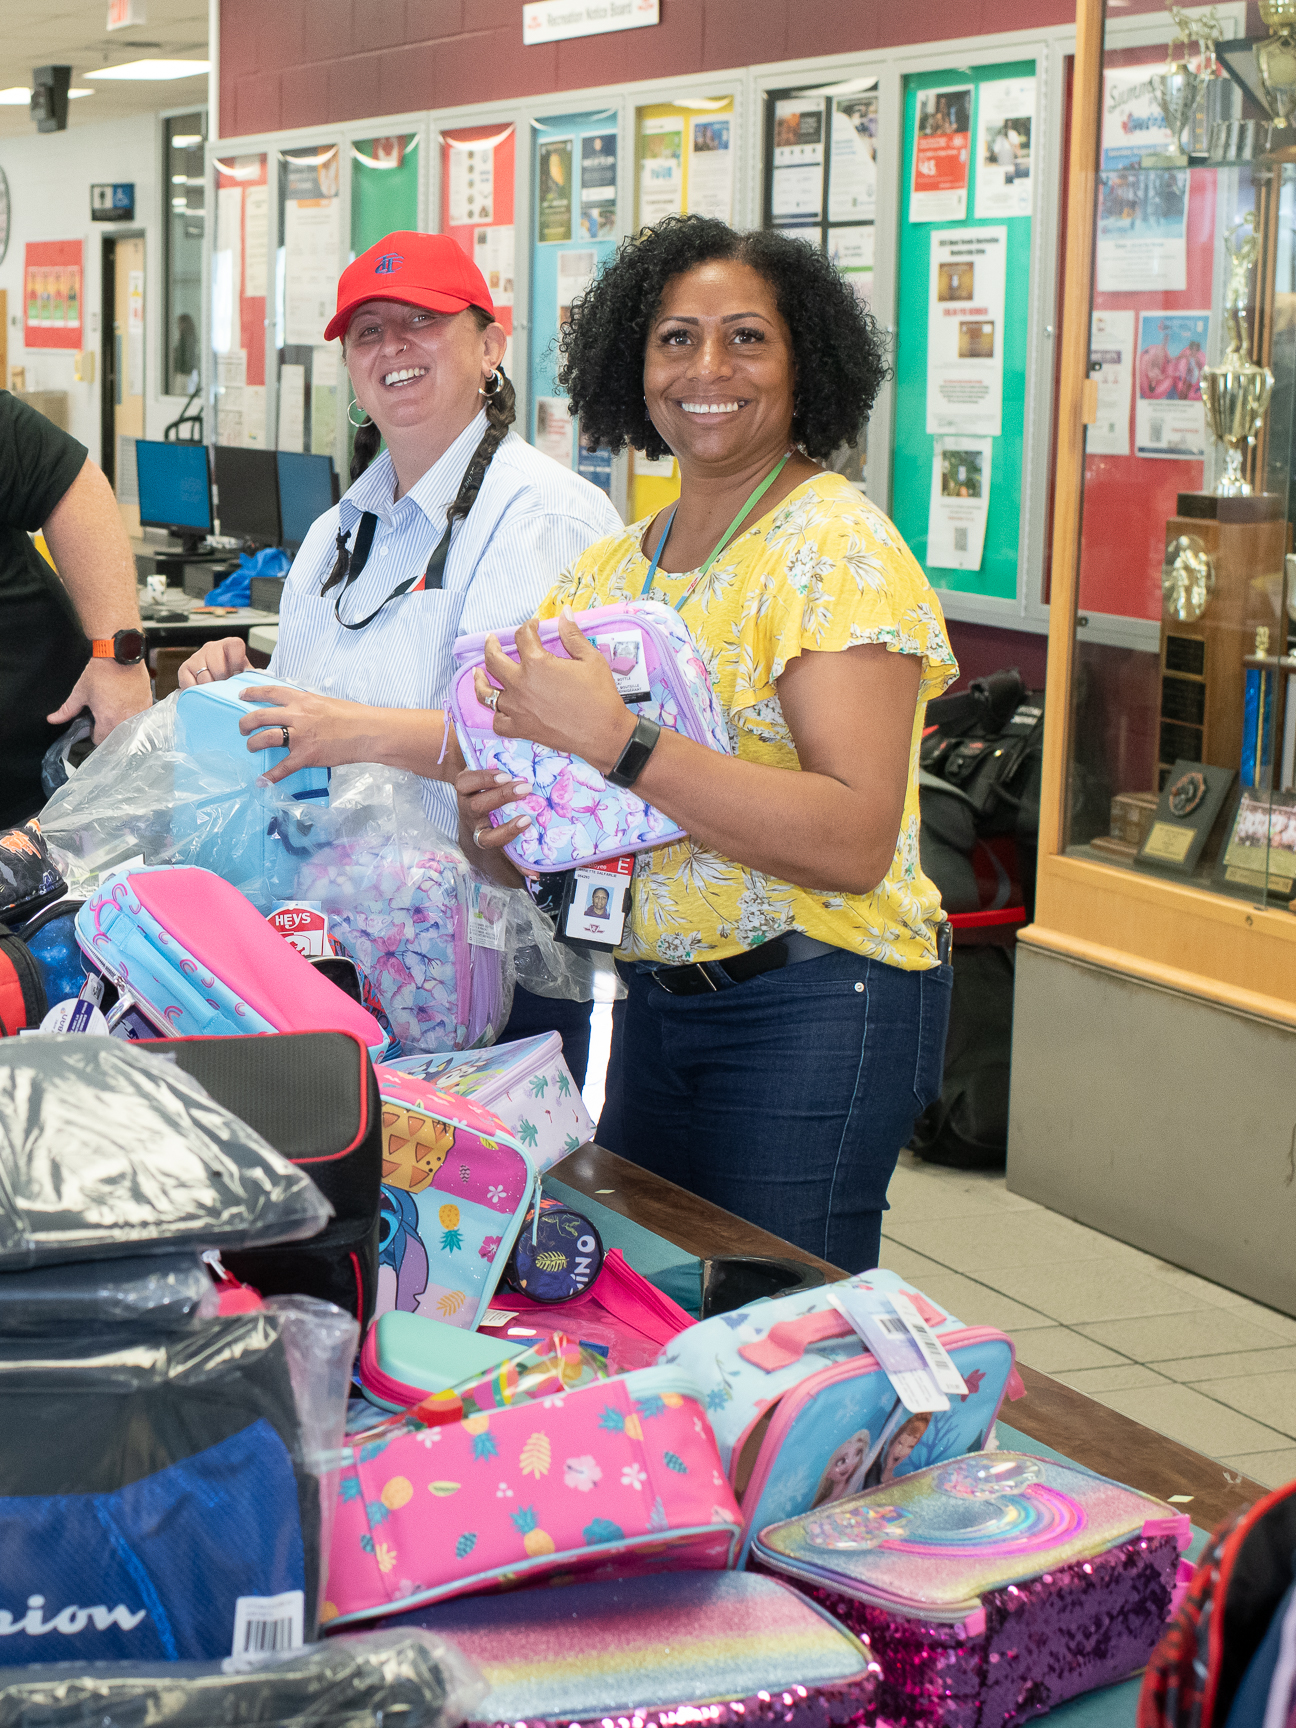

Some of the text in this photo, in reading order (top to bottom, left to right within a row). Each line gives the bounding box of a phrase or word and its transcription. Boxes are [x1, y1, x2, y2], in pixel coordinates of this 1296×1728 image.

[617, 857, 631, 874] E
[275, 912, 311, 930] HEYS
[570, 1235, 596, 1291] INO
